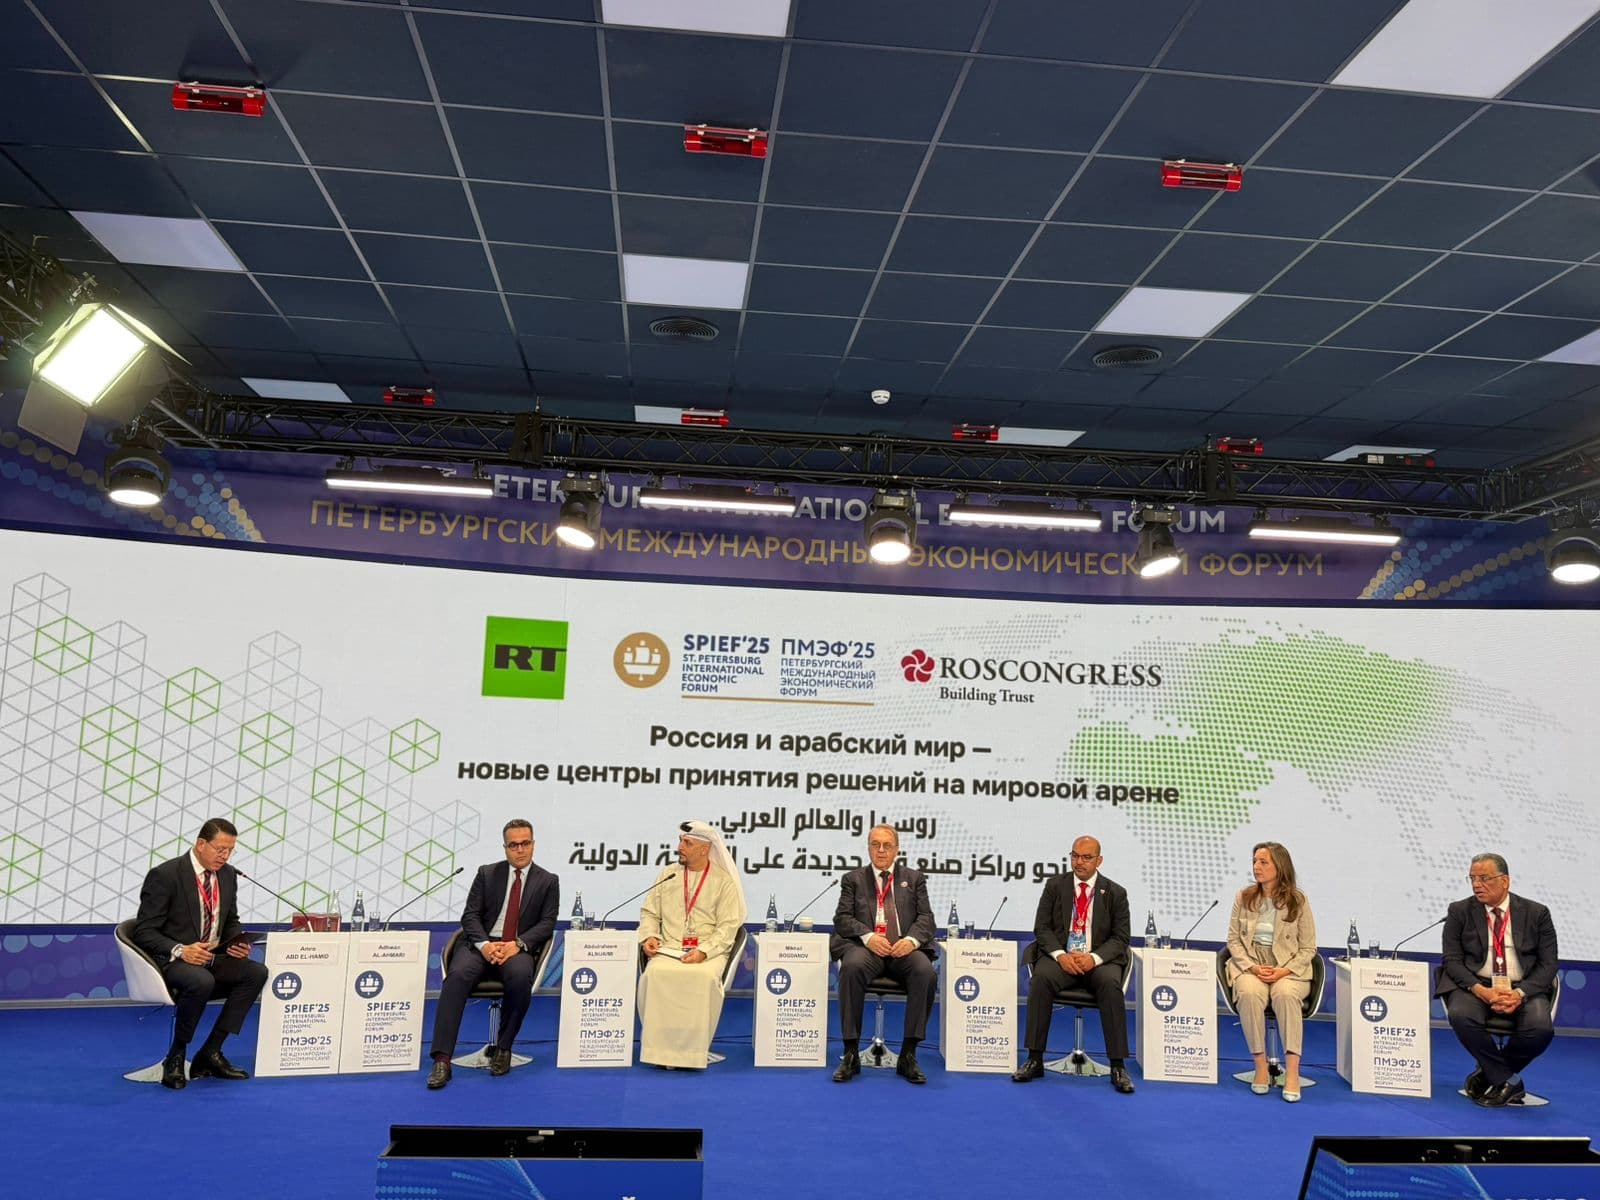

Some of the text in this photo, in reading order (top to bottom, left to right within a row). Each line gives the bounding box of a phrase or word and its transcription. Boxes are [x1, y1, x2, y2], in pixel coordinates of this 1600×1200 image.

[1112, 510, 1225, 533] FOUM
[310, 500, 1322, 576] ПЕТЕРБУРГСКИ МЕЖДУНАРОДНЫ ЭКОНОМИЧЕСК ФОРУМ
[494, 644, 567, 672] RT
[682, 654, 761, 665] ST. PETERSBURG
[682, 664, 764, 675] INTERNATIONAL
[781, 658, 863, 669] ПЕТЕРБУРГСКИЙ
[682, 674, 738, 684] ECONOMIC
[780, 668, 876, 680] МЕЖДУНАРОДНЫЙ
[780, 677, 874, 689] ЭКОНОМИЧЕСКИЙ
[940, 656, 1162, 687] ROSCONGRESS
[681, 684, 718, 692] FORUM
[780, 687, 817, 697] ФОРУМ
[940, 687, 1035, 706] Building Trust
[650, 725, 748, 750] Россия
[756, 734, 772, 750] и
[779, 732, 907, 756] арабский
[914, 740, 966, 762] мир
[458, 761, 1180, 806] новые центры принятия решений на мировой арене
[792, 808, 863, 840] والعالم
[568, 842, 648, 872] الدولية
[744, 846, 784, 874] على
[968, 854, 1026, 882] مراكز
[1032, 857, 1067, 884] نحو
